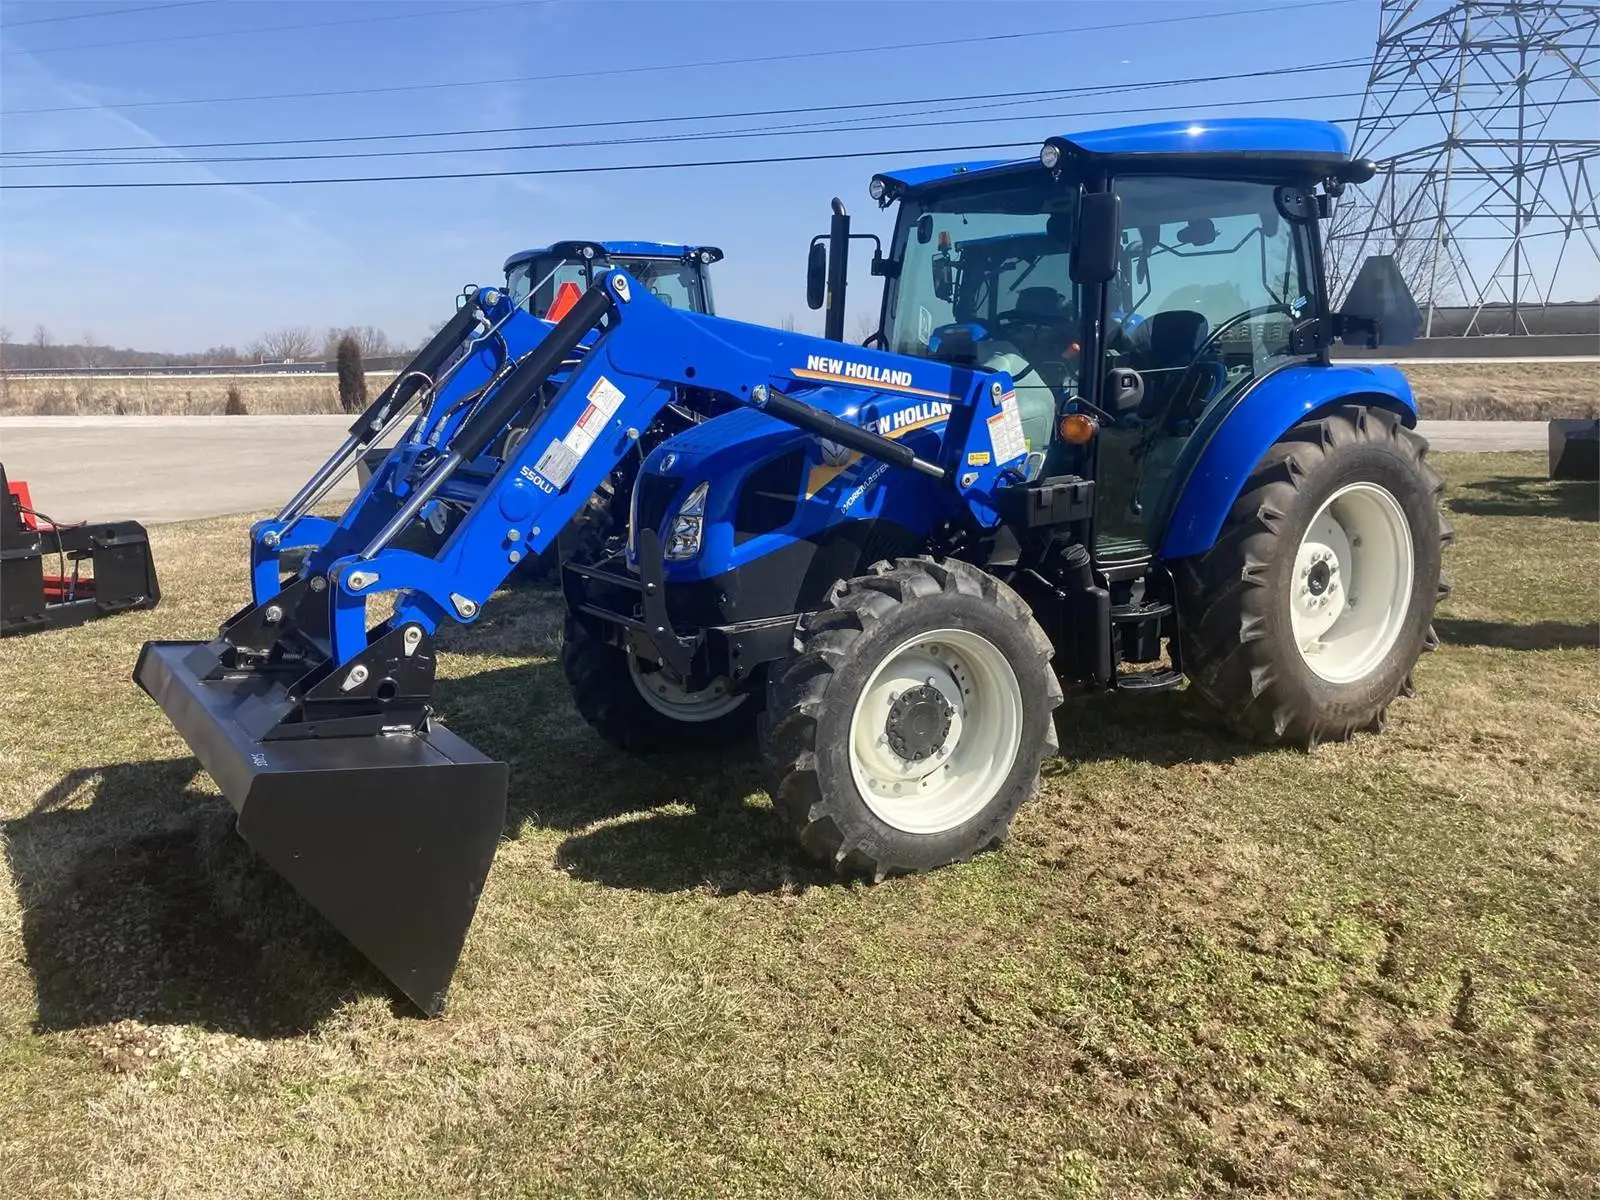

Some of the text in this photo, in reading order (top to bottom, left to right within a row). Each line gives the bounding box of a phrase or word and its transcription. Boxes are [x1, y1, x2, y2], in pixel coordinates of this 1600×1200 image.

[807, 355, 912, 387] NEW HOLLAND
[862, 401, 952, 434] EW HOLLAN
